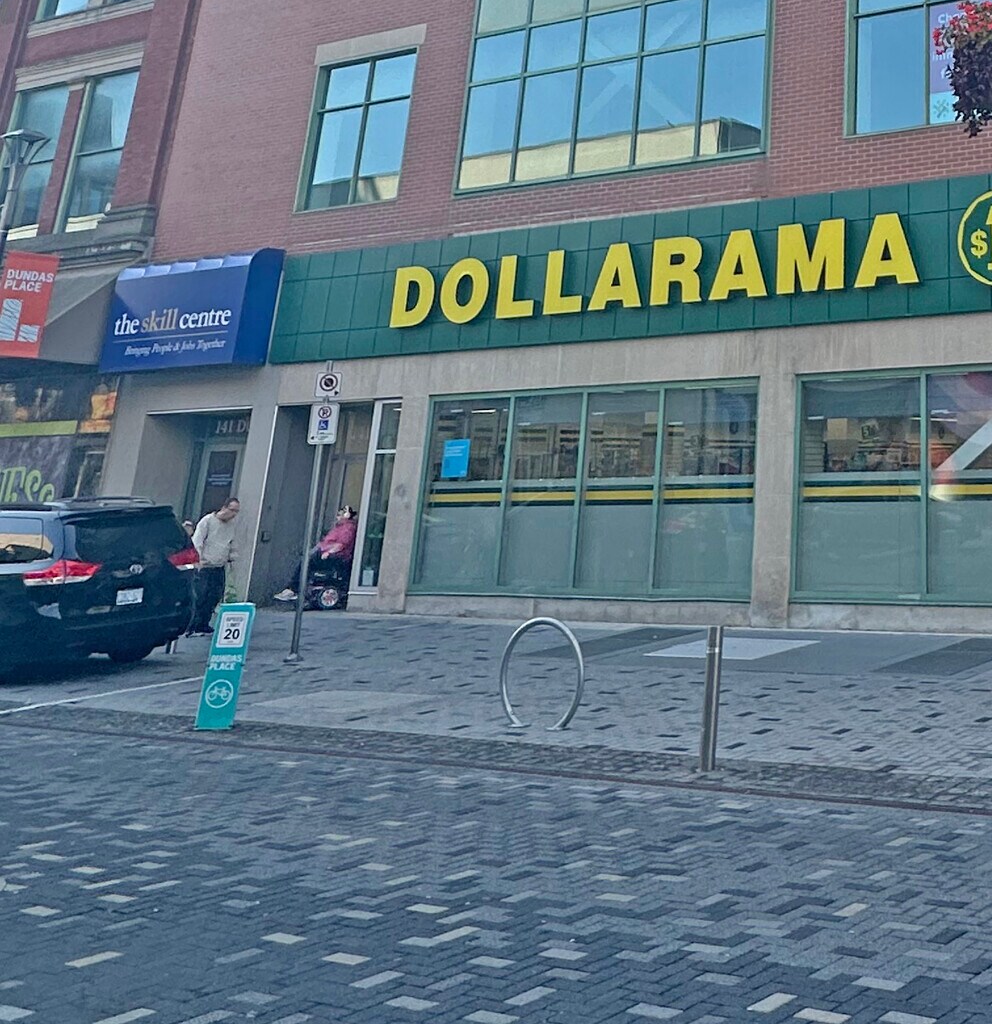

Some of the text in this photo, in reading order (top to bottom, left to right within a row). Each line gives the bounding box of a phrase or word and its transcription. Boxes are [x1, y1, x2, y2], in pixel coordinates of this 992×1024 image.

[6, 268, 55, 283] DUNDAS
[388, 212, 919, 328] DOLLARAMA
[3, 279, 42, 293] PLACE
[114, 308, 232, 336] the skill centre
[151, 342, 172, 355] People
[215, 420, 234, 434] 141
[223, 628, 241, 640] 20
[210, 655, 243, 663] DUNDAS
[208, 662, 237, 671] PLACE
